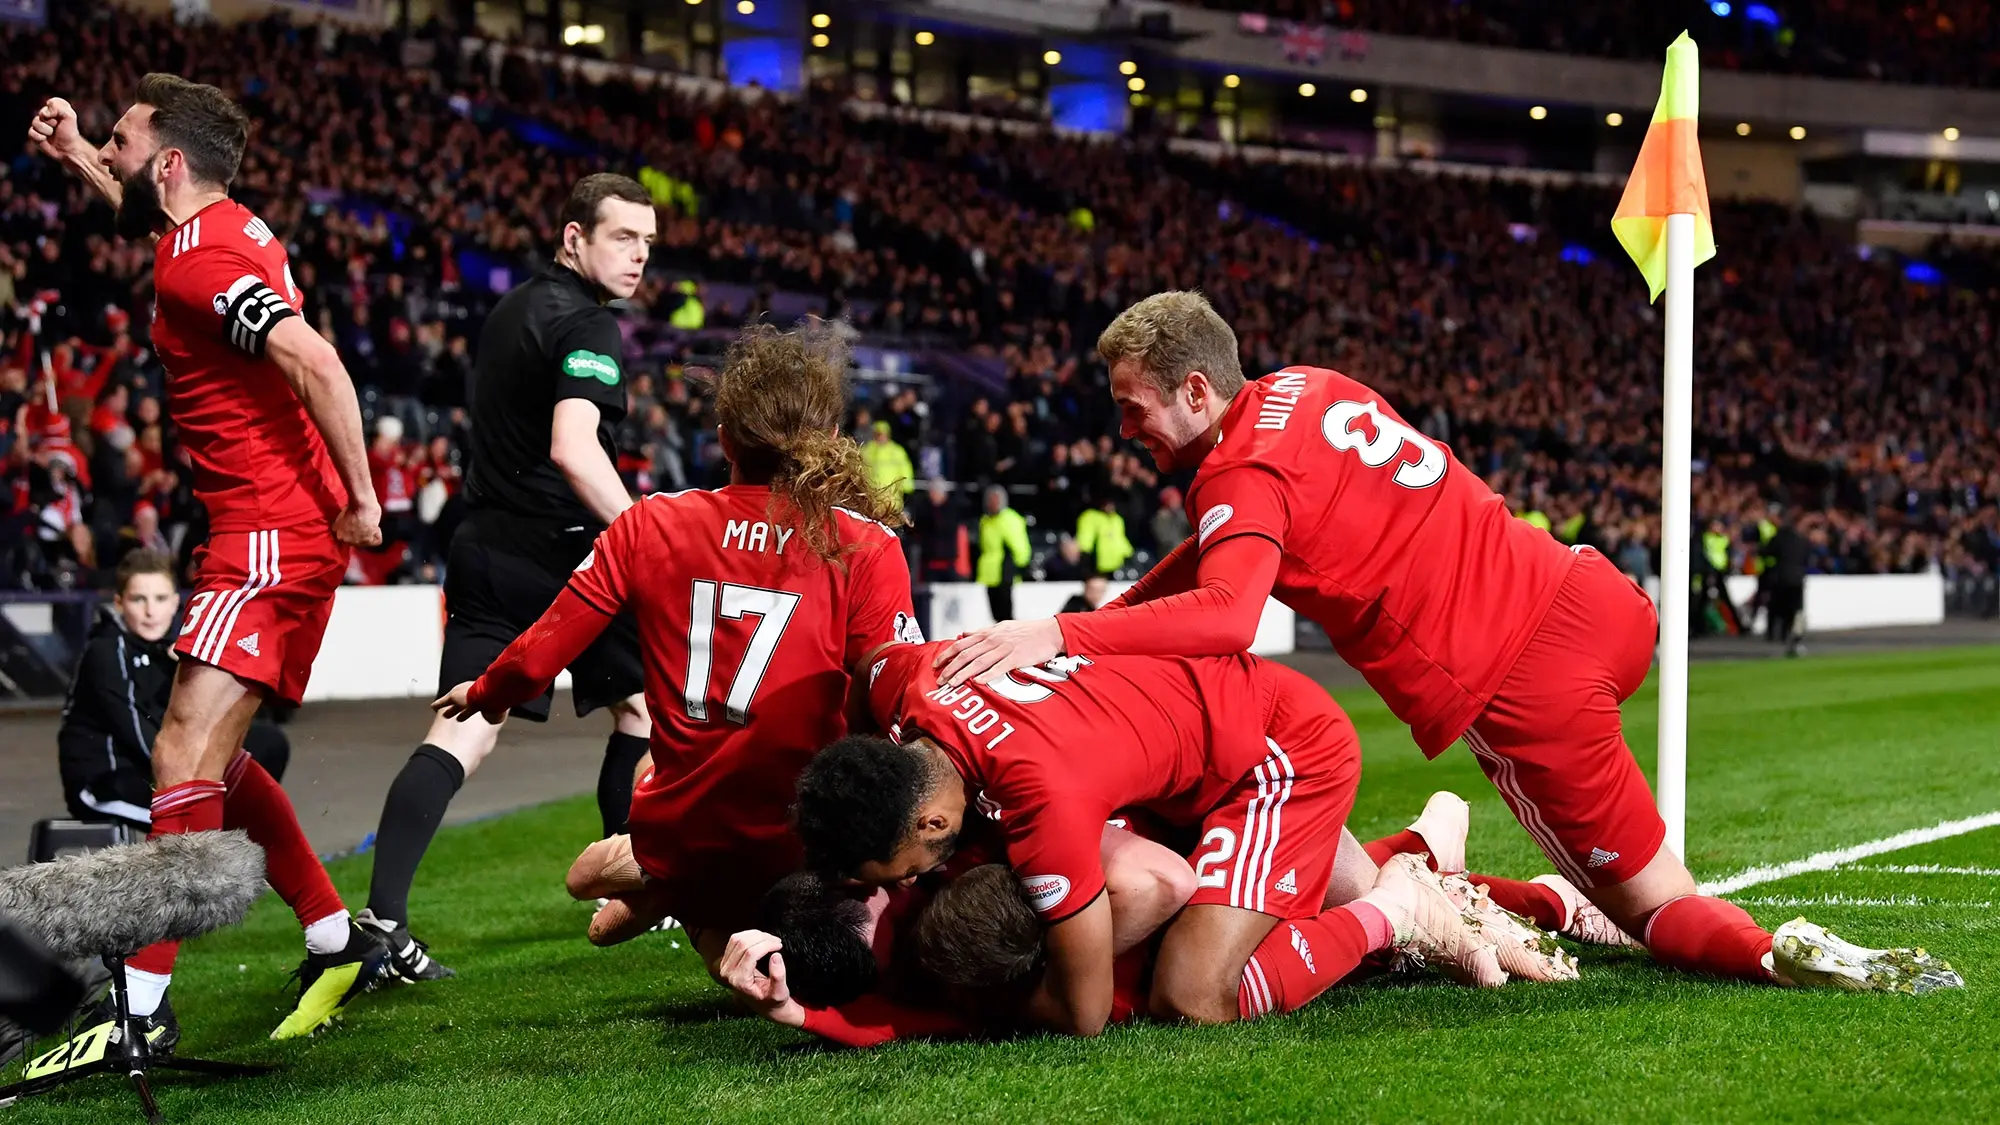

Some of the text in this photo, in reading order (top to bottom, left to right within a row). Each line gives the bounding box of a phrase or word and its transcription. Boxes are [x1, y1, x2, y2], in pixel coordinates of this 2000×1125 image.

[238, 297, 271, 332] C
[1321, 400, 1448, 489] 9
[722, 519, 794, 555] MAY
[180, 591, 215, 635] 3
[683, 577, 803, 728] 17
[1195, 826, 1237, 888] 2
[1587, 851, 1620, 868] adidas
[1274, 882, 1298, 896] adidas
